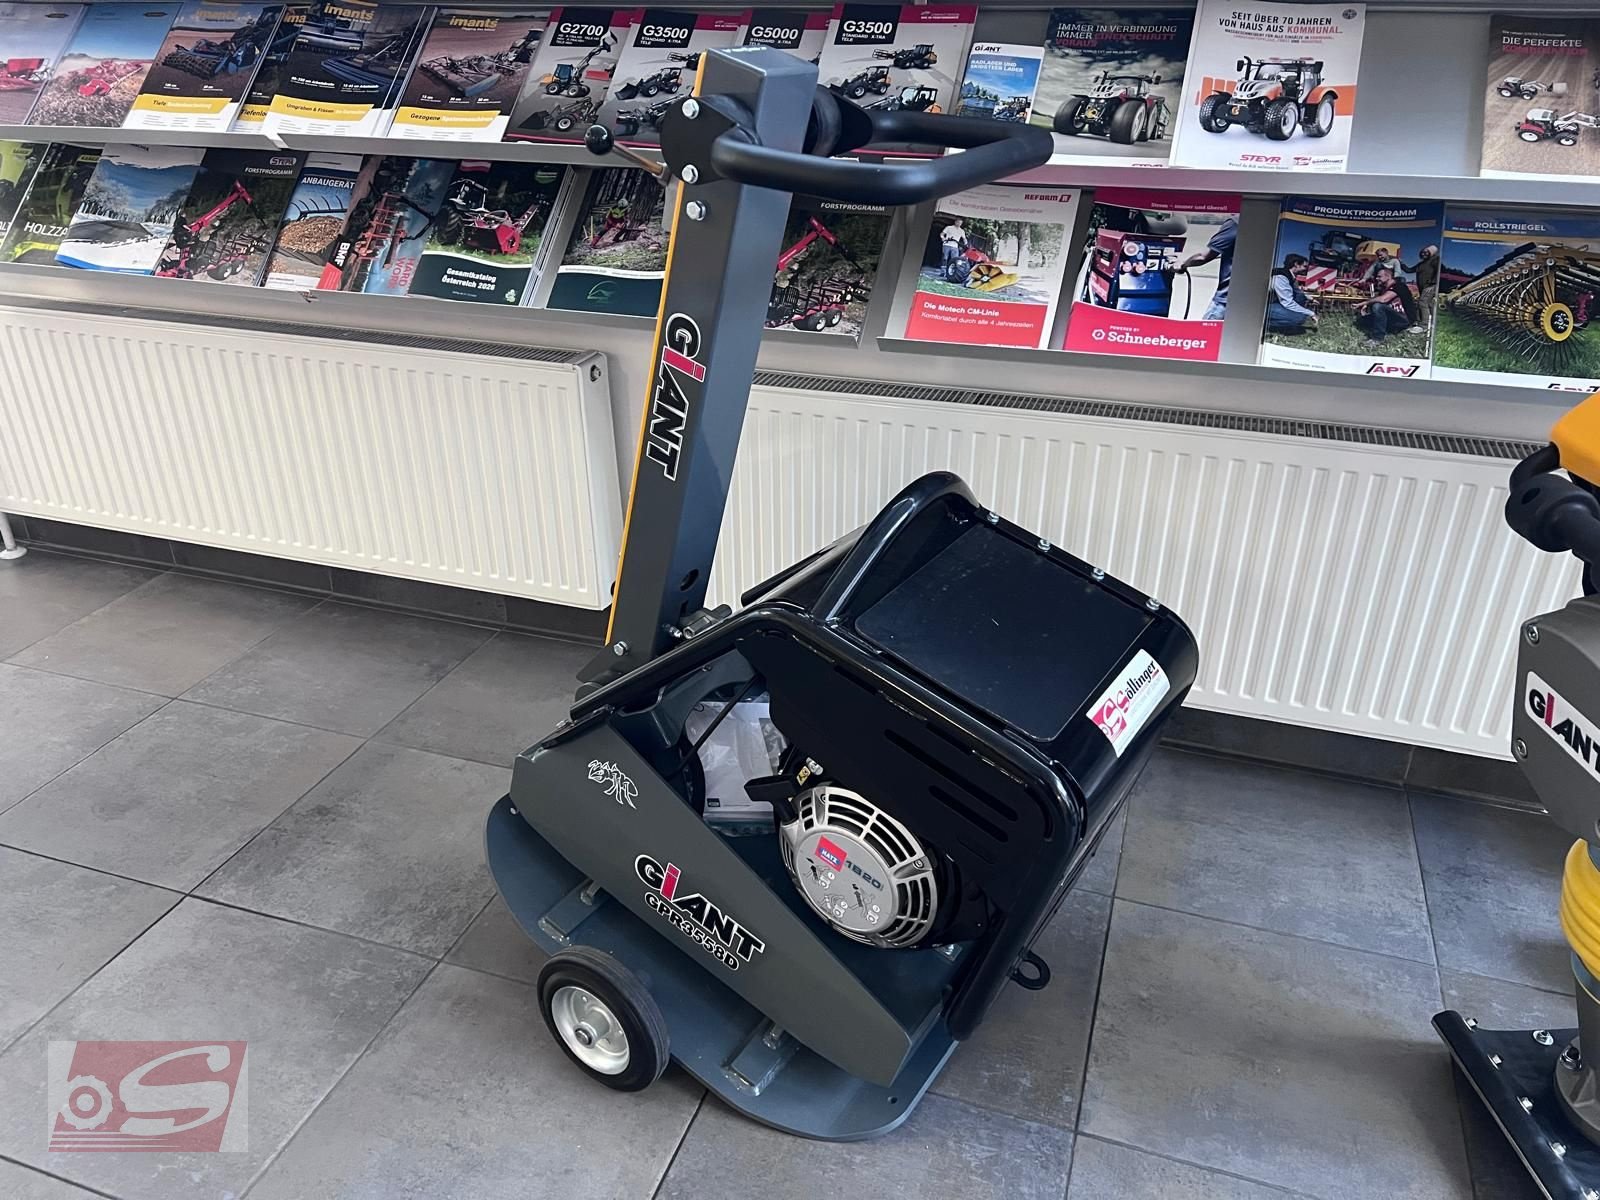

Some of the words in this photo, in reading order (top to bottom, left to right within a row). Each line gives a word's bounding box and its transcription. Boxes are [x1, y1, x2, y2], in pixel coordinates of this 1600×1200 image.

[283, 13, 307, 23] ima
[324, 3, 376, 21] imants
[1232, 11, 1252, 21] SEIT
[1254, 13, 1280, 24] ÜBER
[1282, 17, 1294, 25] 70
[1296, 17, 1332, 26] JAHREN
[449, 15, 499, 28] imants
[843, 20, 893, 35] G3500
[1057, 23, 1094, 32] IMMER
[1096, 24, 1107, 32] IN
[1110, 25, 1177, 33] VERBINDUNG
[1219, 18, 1237, 27] VON
[1240, 22, 1264, 32] HAUS
[1266, 25, 1284, 33] AUS
[559, 22, 604, 37] G2700
[642, 25, 689, 39] G3500
[751, 26, 799, 40] G5000
[1056, 31, 1093, 39] IMMER
[1055, 39, 1098, 47] VORAUS
[1502, 36, 1521, 45] DIE
[1523, 38, 1583, 48] PERFEKTE
[286, 103, 313, 114] Umgraben
[410, 112, 441, 121] Gezogene
[1240, 154, 1281, 164] STEYR
[245, 167, 293, 175] FORSTPROGRAMM
[300, 176, 356, 190] ANBAUGERÄT
[821, 202, 885, 212] FORSTPROGRAMM
[1314, 205, 1417, 217] PRODUKTPROGRAMM
[24, 221, 69, 237] HOLZZA
[1475, 221, 1546, 231] ROLLSTRIEGEL
[334, 242, 351, 267] BMF
[399, 255, 416, 287] HARD
[446, 268, 497, 283] Gesamtkatalog
[441, 274, 477, 288] Österreich
[923, 301, 937, 310] Die
[938, 304, 966, 314] Motech
[967, 307, 1000, 317] CM-Linie
[921, 312, 958, 323] Komfortabel
[977, 318, 988, 326] alle
[995, 319, 1035, 329] Jahreszeiten
[1107, 331, 1208, 351] Schneeberger
[821, 849, 839, 865] HATZ
[845, 860, 881, 890] 1B20
[644, 892, 739, 971] GPR3558D
